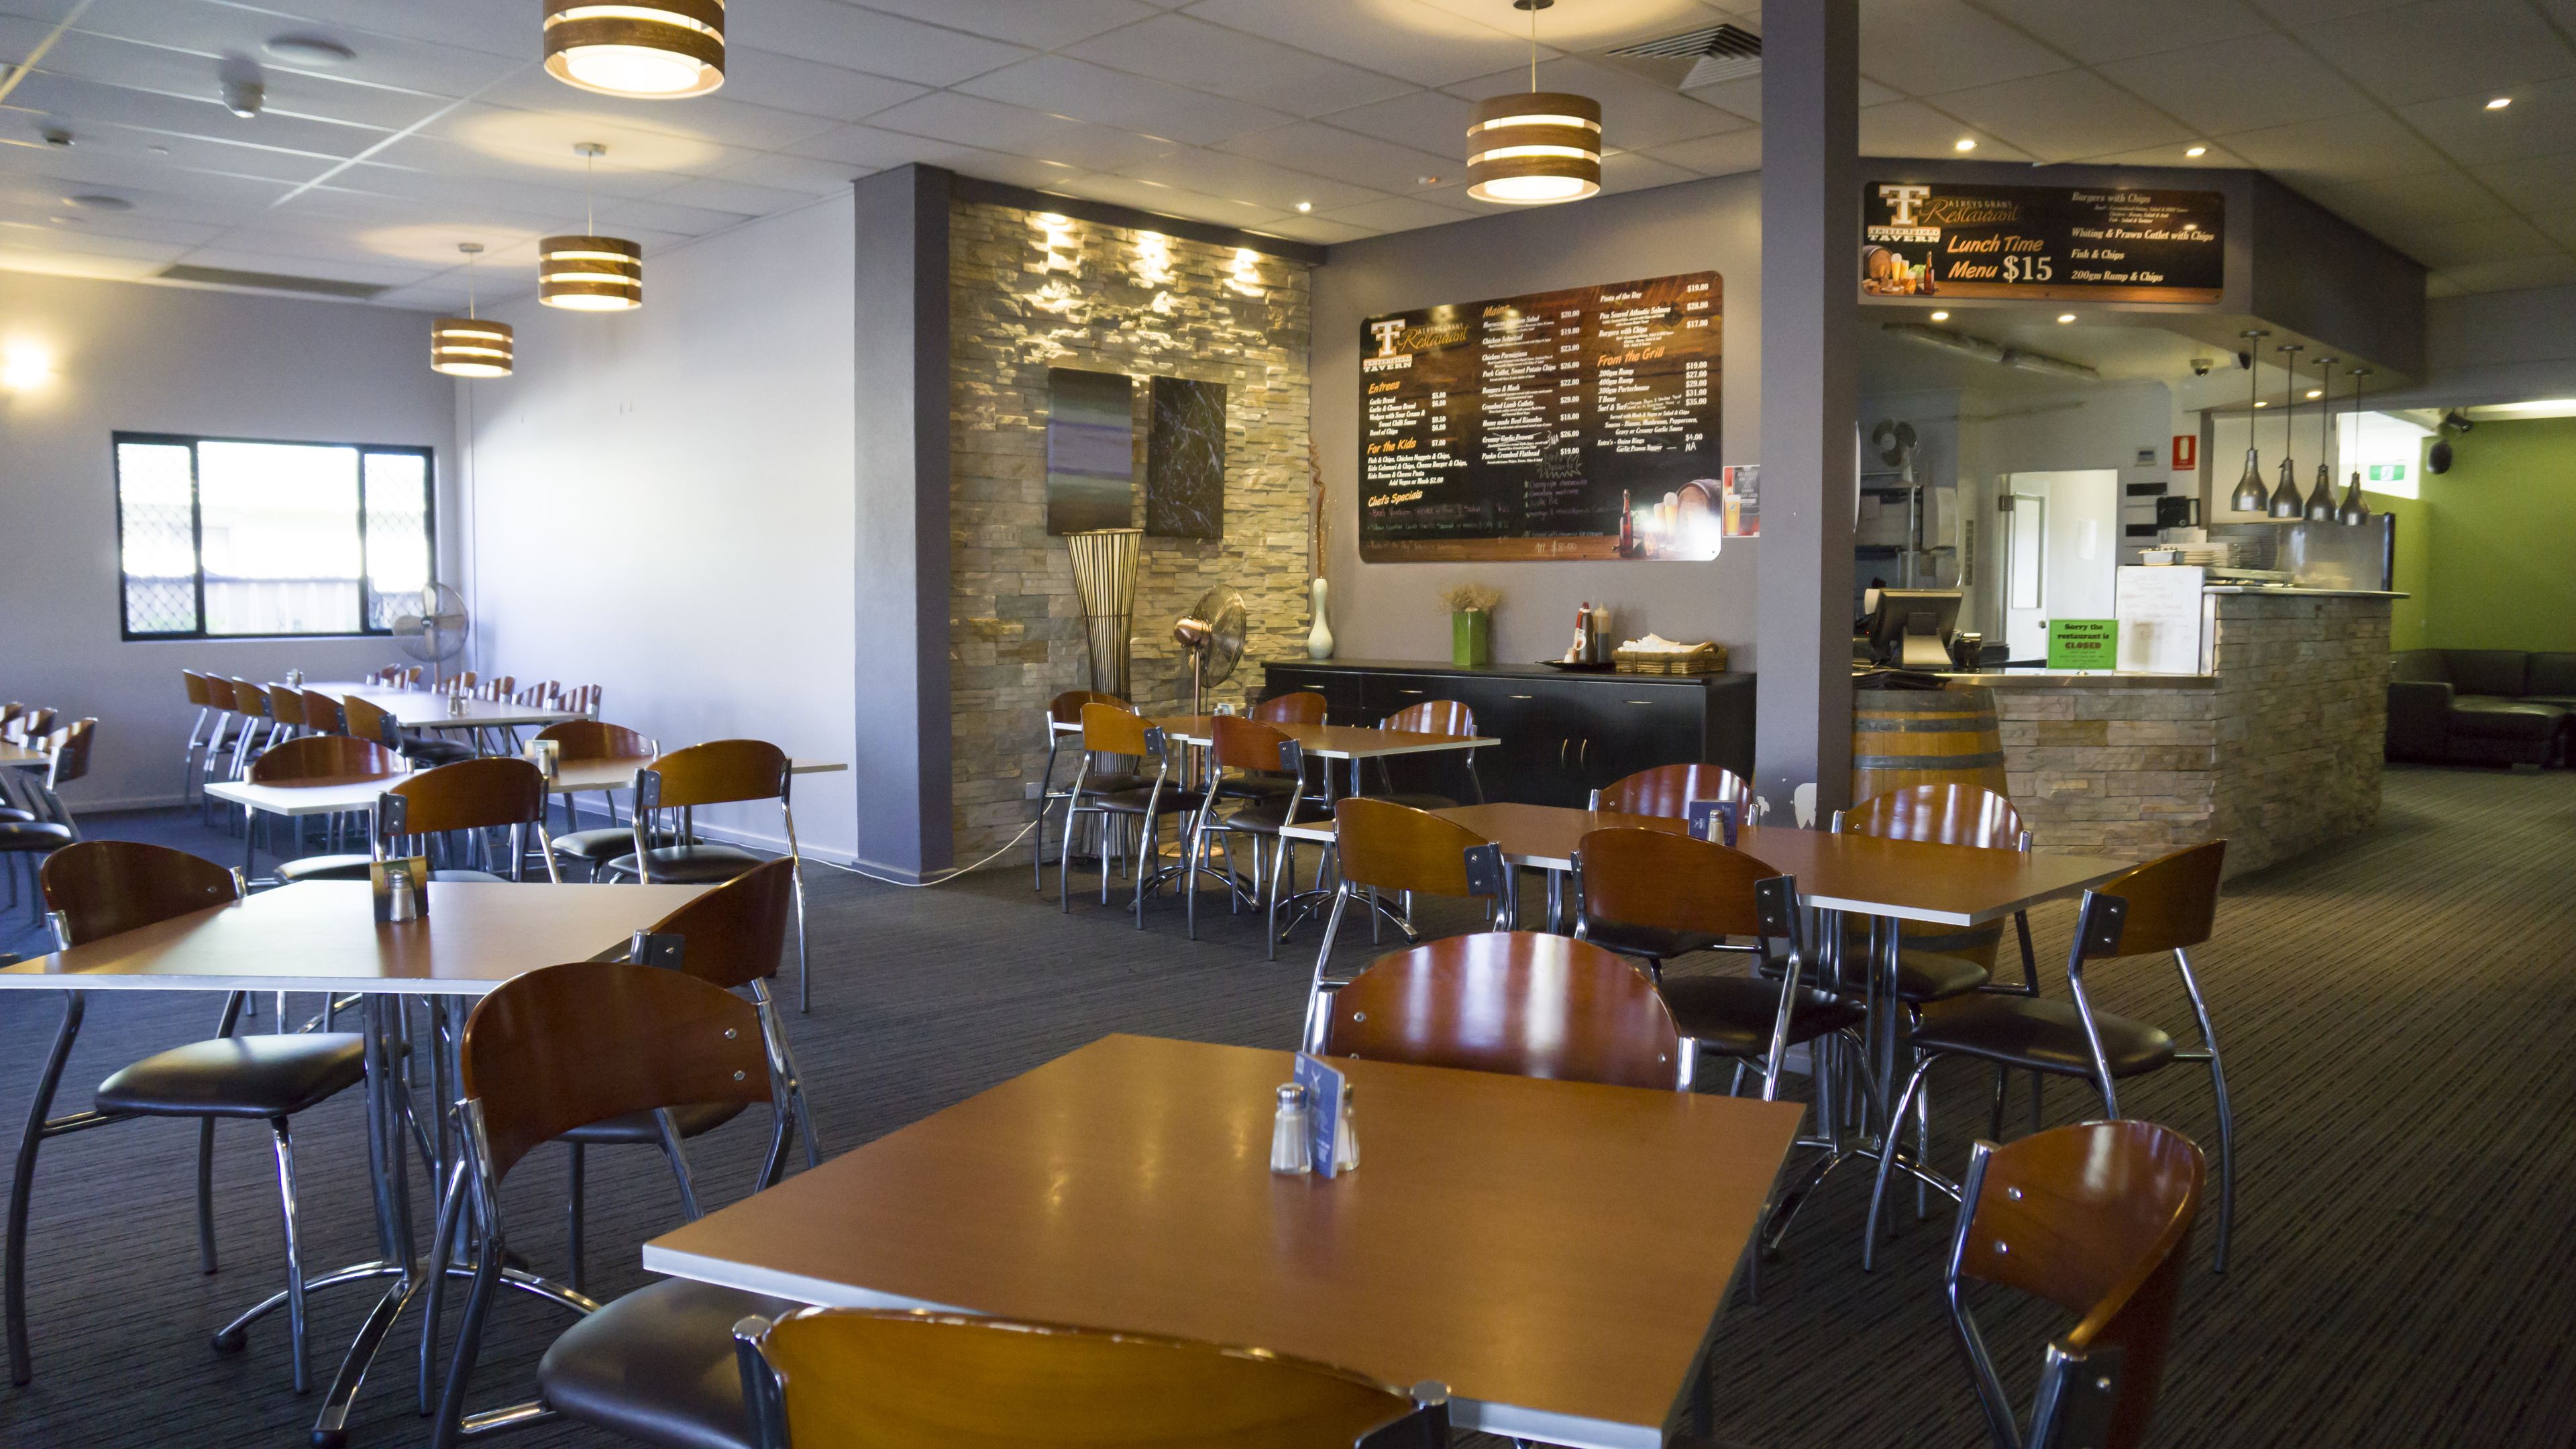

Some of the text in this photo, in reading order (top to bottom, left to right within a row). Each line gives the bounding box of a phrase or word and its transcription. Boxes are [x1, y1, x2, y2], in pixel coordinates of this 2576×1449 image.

[2072, 192, 2151, 204] Burgers with Chips
[1919, 201, 2019, 223] Restaurant
[1868, 235, 1941, 243] TAVERN
[2072, 227, 2214, 242] Whiting & Prawn Cutlet with Chips
[1947, 234, 2044, 253] Lunch Time
[2071, 249, 2125, 260] Fish & Chips
[1947, 254, 2053, 283] Menu $15
[2071, 270, 2163, 282] 200gm Rump & Chips
[1687, 283, 1709, 292] $19.00
[1483, 305, 1511, 318] Mains
[1611, 311, 1628, 319] Seared
[1629, 309, 1650, 317] Atlantic
[1687, 301, 1709, 311] $28.00
[1526, 310, 1580, 323] Salad $20.00
[1686, 319, 1708, 329] $17.00
[1560, 327, 1580, 335] $19.00
[1397, 325, 1471, 352] Restaurant
[1560, 344, 1580, 353] $23.00
[1597, 346, 1665, 368] From the Grill
[1363, 362, 1412, 372] TAVERN
[1560, 362, 1580, 370] $26.00
[1686, 361, 1707, 370] $19.00
[1560, 379, 1579, 387] $22.00
[1599, 378, 1617, 386] 400gm
[1686, 370, 1707, 379] $27.00
[1368, 381, 1401, 394] Entrees
[1618, 384, 1650, 393] Porterhouse
[1686, 379, 1707, 388] $29.00
[1432, 392, 1446, 400] $5.00
[1685, 388, 1707, 397] $31.00
[1432, 400, 1446, 408] $6.00
[1482, 402, 1503, 411] Crumbed
[1560, 396, 1579, 405] $29.00
[1685, 398, 1707, 407] $35.00
[1560, 413, 1579, 421] $18.00
[1560, 430, 1579, 438] $26.00
[1367, 437, 1446, 454] For the Kids $7.00
[1685, 442, 1697, 451] NA
[1368, 490, 1423, 507] Chefs Specials
